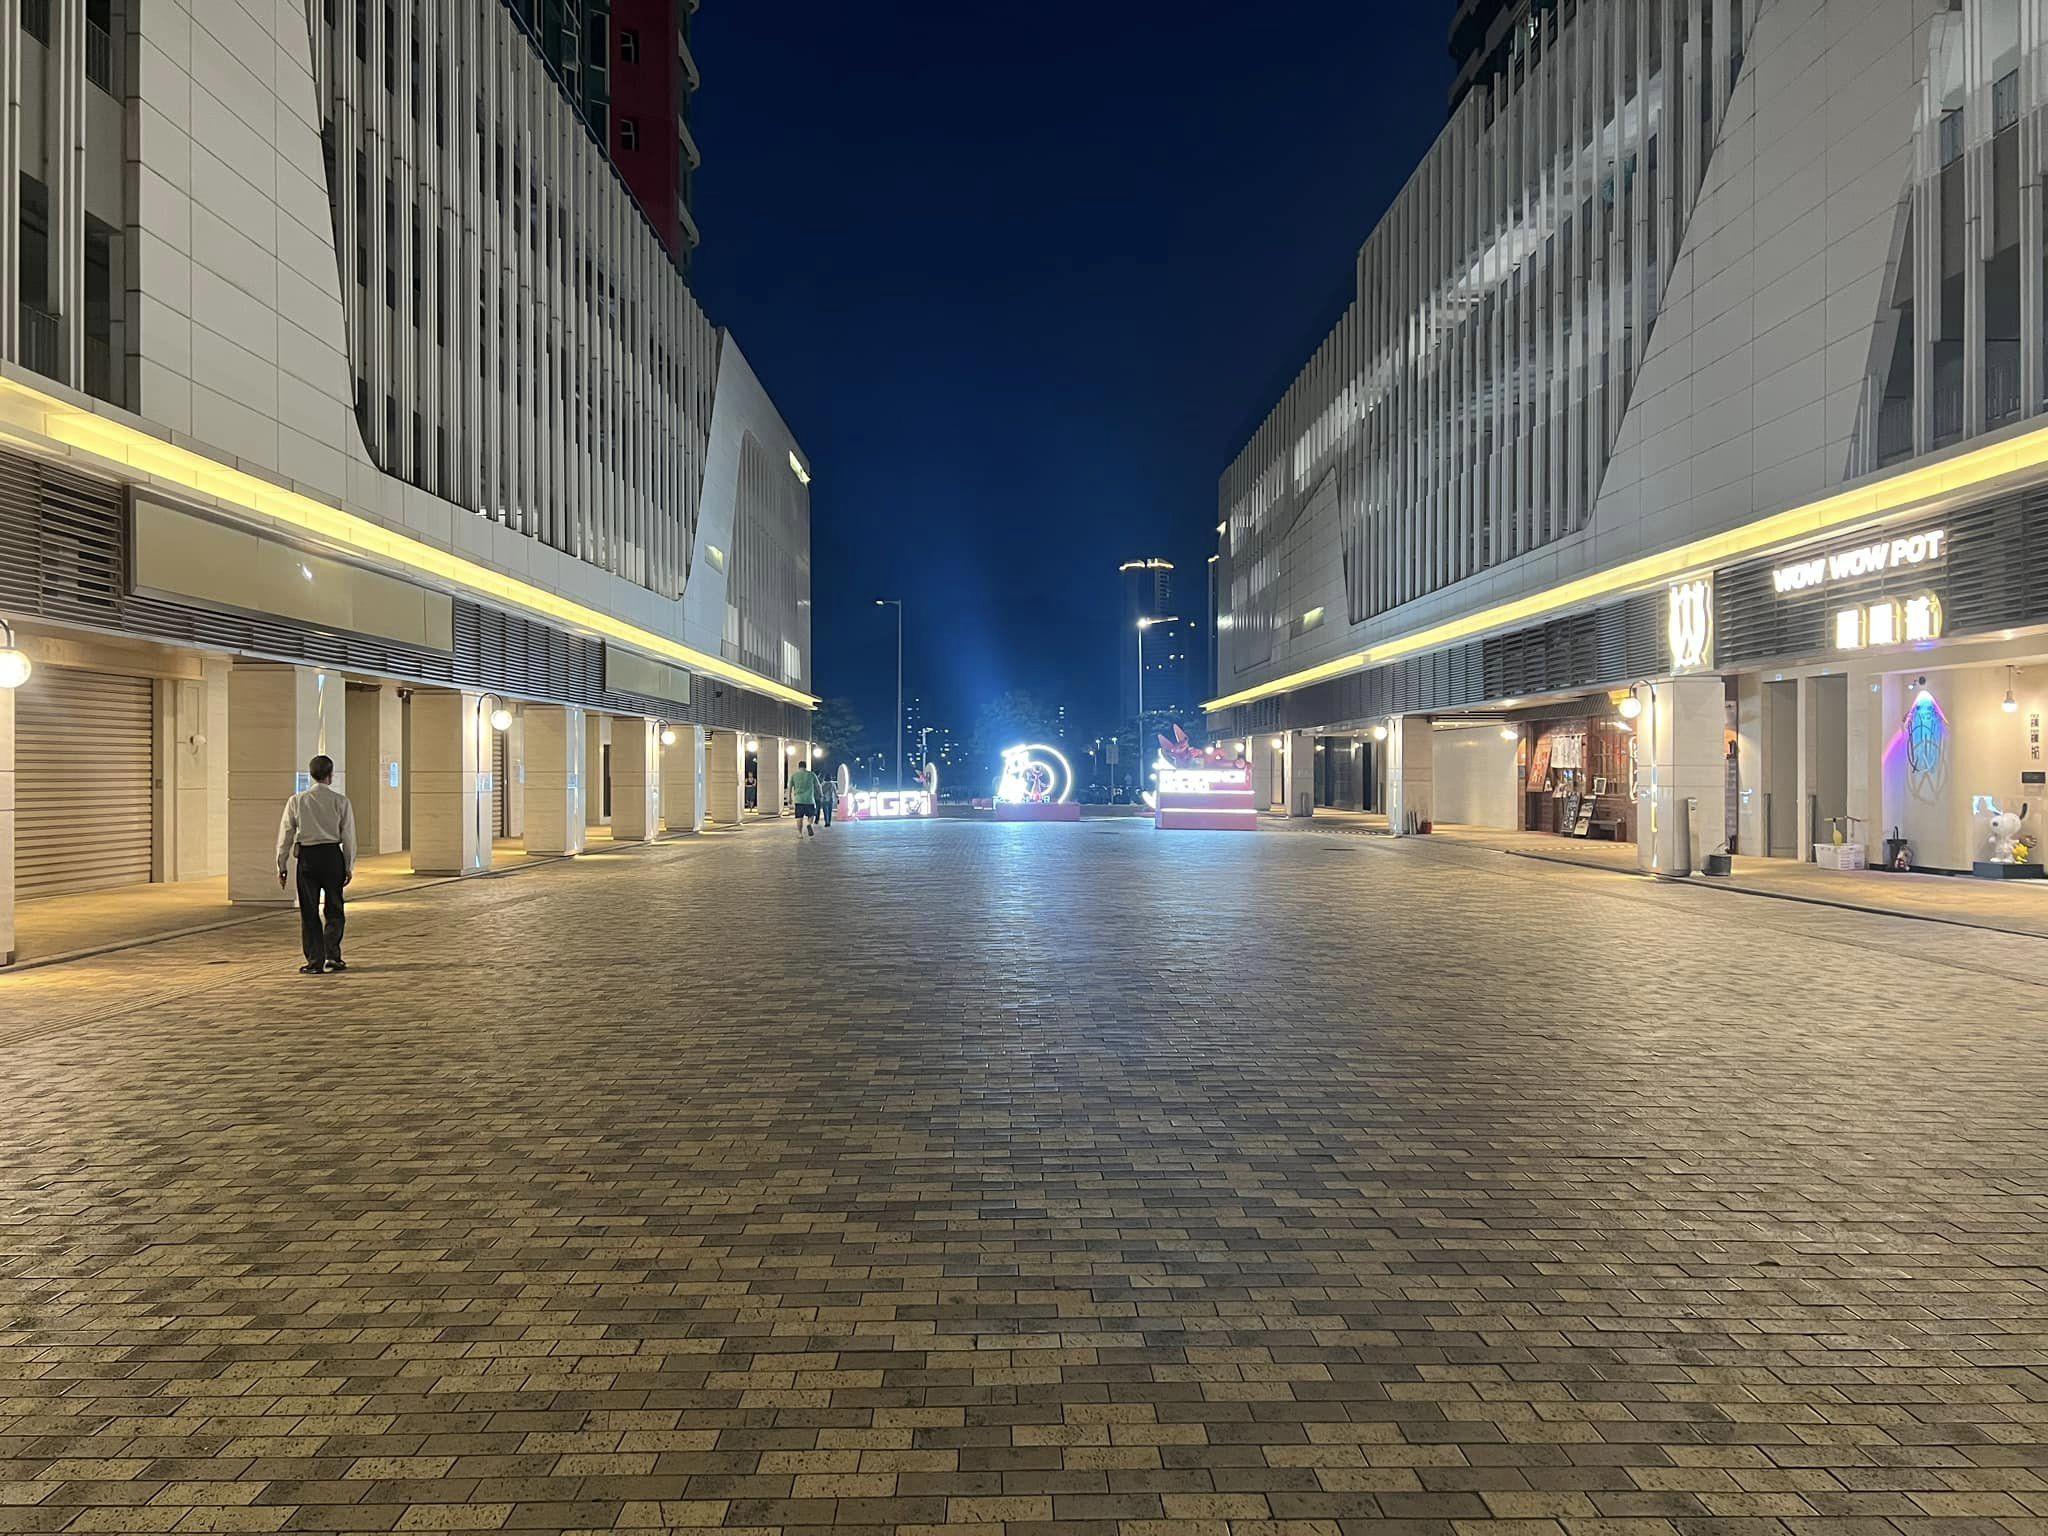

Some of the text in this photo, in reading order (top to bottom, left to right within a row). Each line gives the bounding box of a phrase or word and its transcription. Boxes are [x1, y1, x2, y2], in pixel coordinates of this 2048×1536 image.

[1772, 529, 1944, 593] WOW WOW POT
